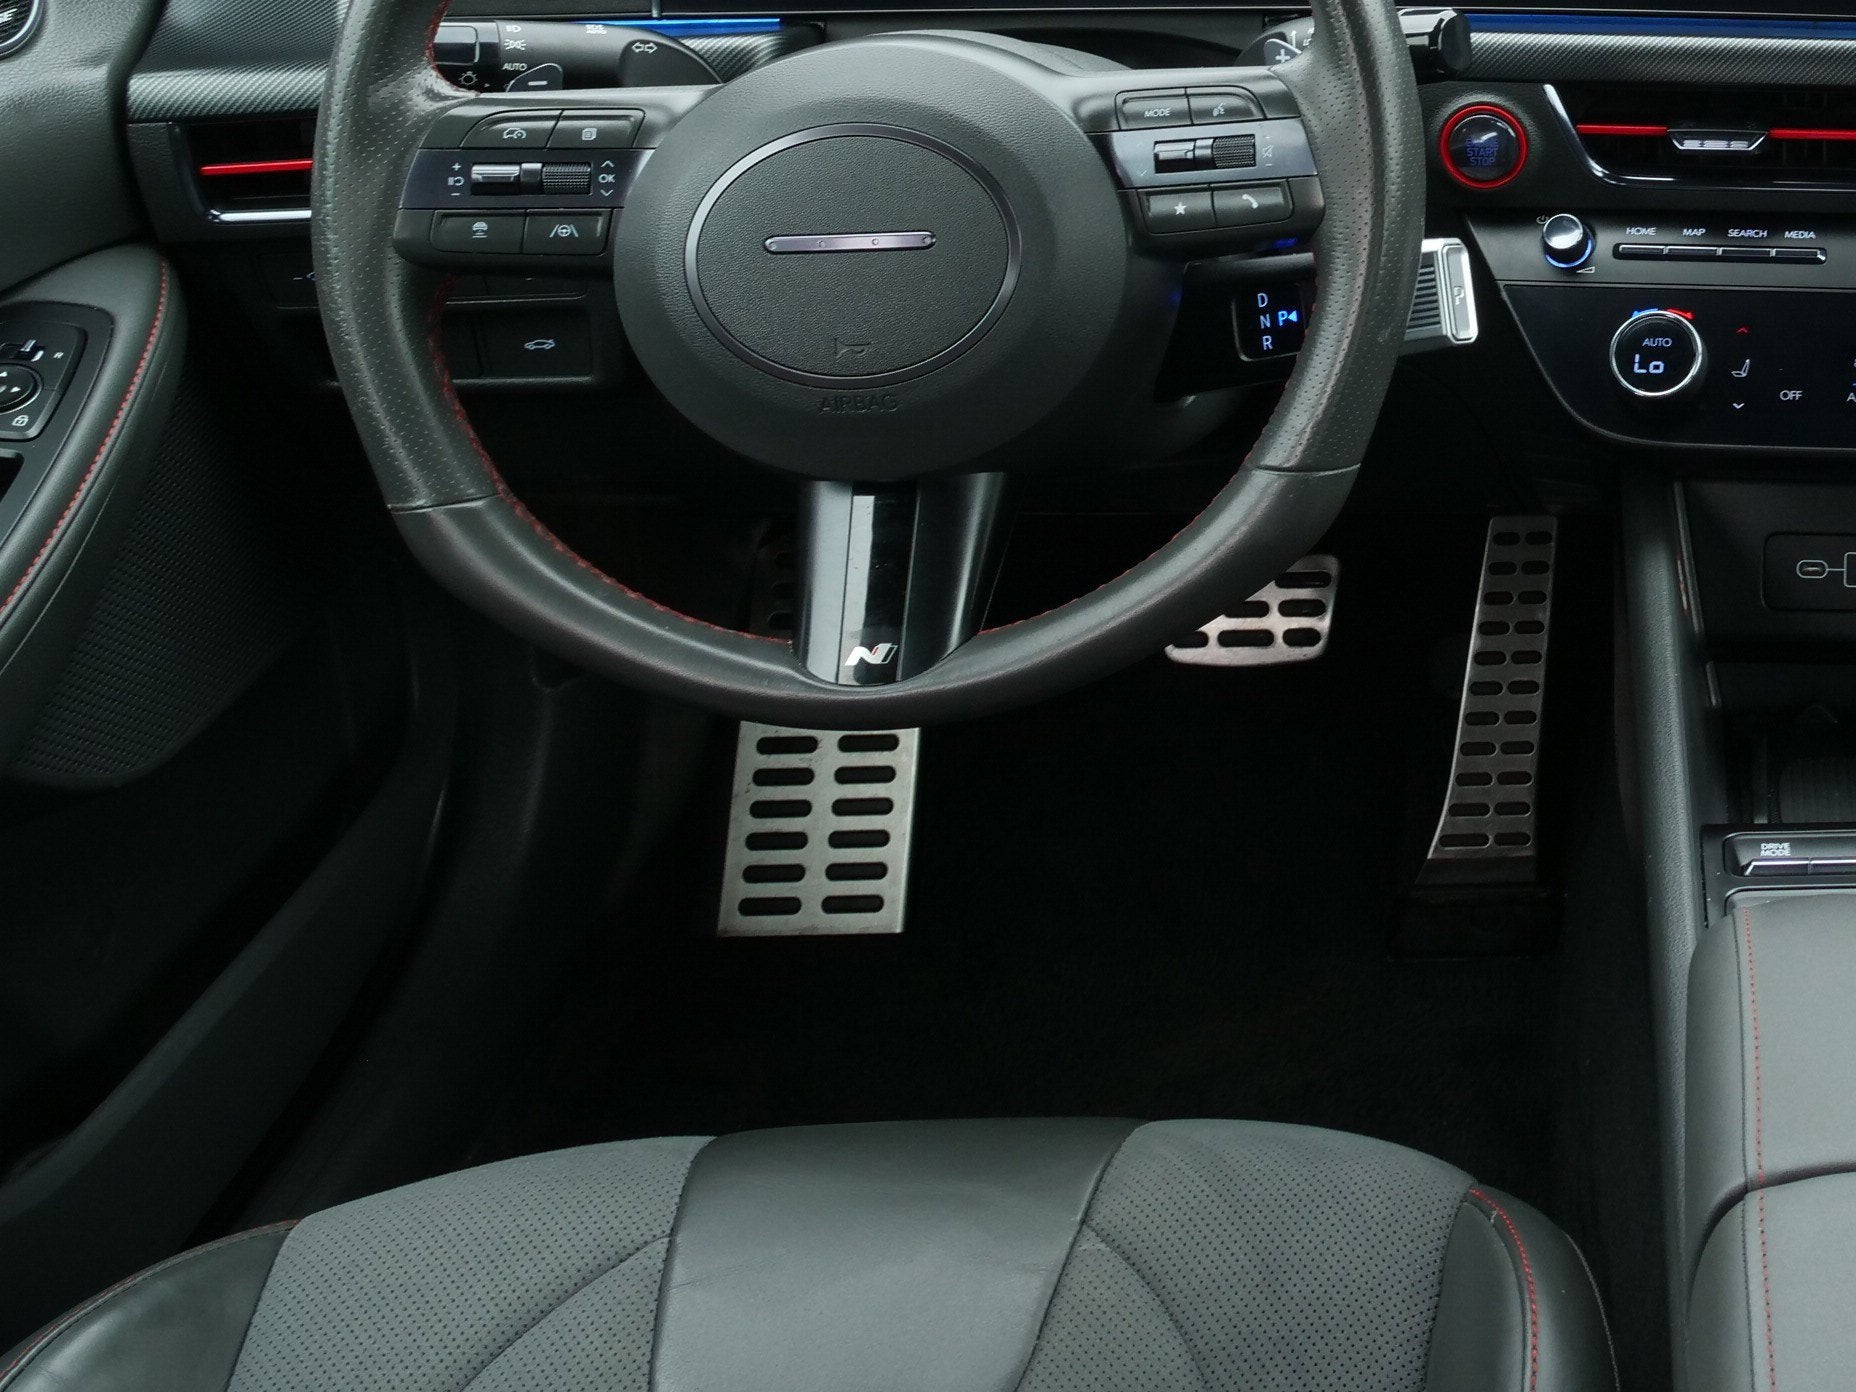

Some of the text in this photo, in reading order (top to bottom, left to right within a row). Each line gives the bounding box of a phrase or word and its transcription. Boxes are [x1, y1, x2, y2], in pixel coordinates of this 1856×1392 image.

[502, 62, 528, 71] AUTO
[1143, 108, 1171, 117] MODE
[1466, 147, 1498, 157] START
[1469, 157, 1496, 166] STOP
[598, 173, 616, 183] OK
[1625, 226, 1657, 236] HOME
[1682, 228, 1706, 237] MAP
[1727, 229, 1768, 238] SEARCH
[1784, 230, 1816, 239] MEDIA
[1257, 293, 1269, 308] D
[1260, 314, 1271, 329] N
[1277, 310, 1288, 326] P
[1262, 335, 1273, 351] R
[1642, 337, 1673, 347] AUTO
[1633, 353, 1665, 374] Lo
[1779, 390, 1803, 401] OFF
[818, 394, 899, 414] AIRBAG
[1760, 842, 1790, 850] DRIVE
